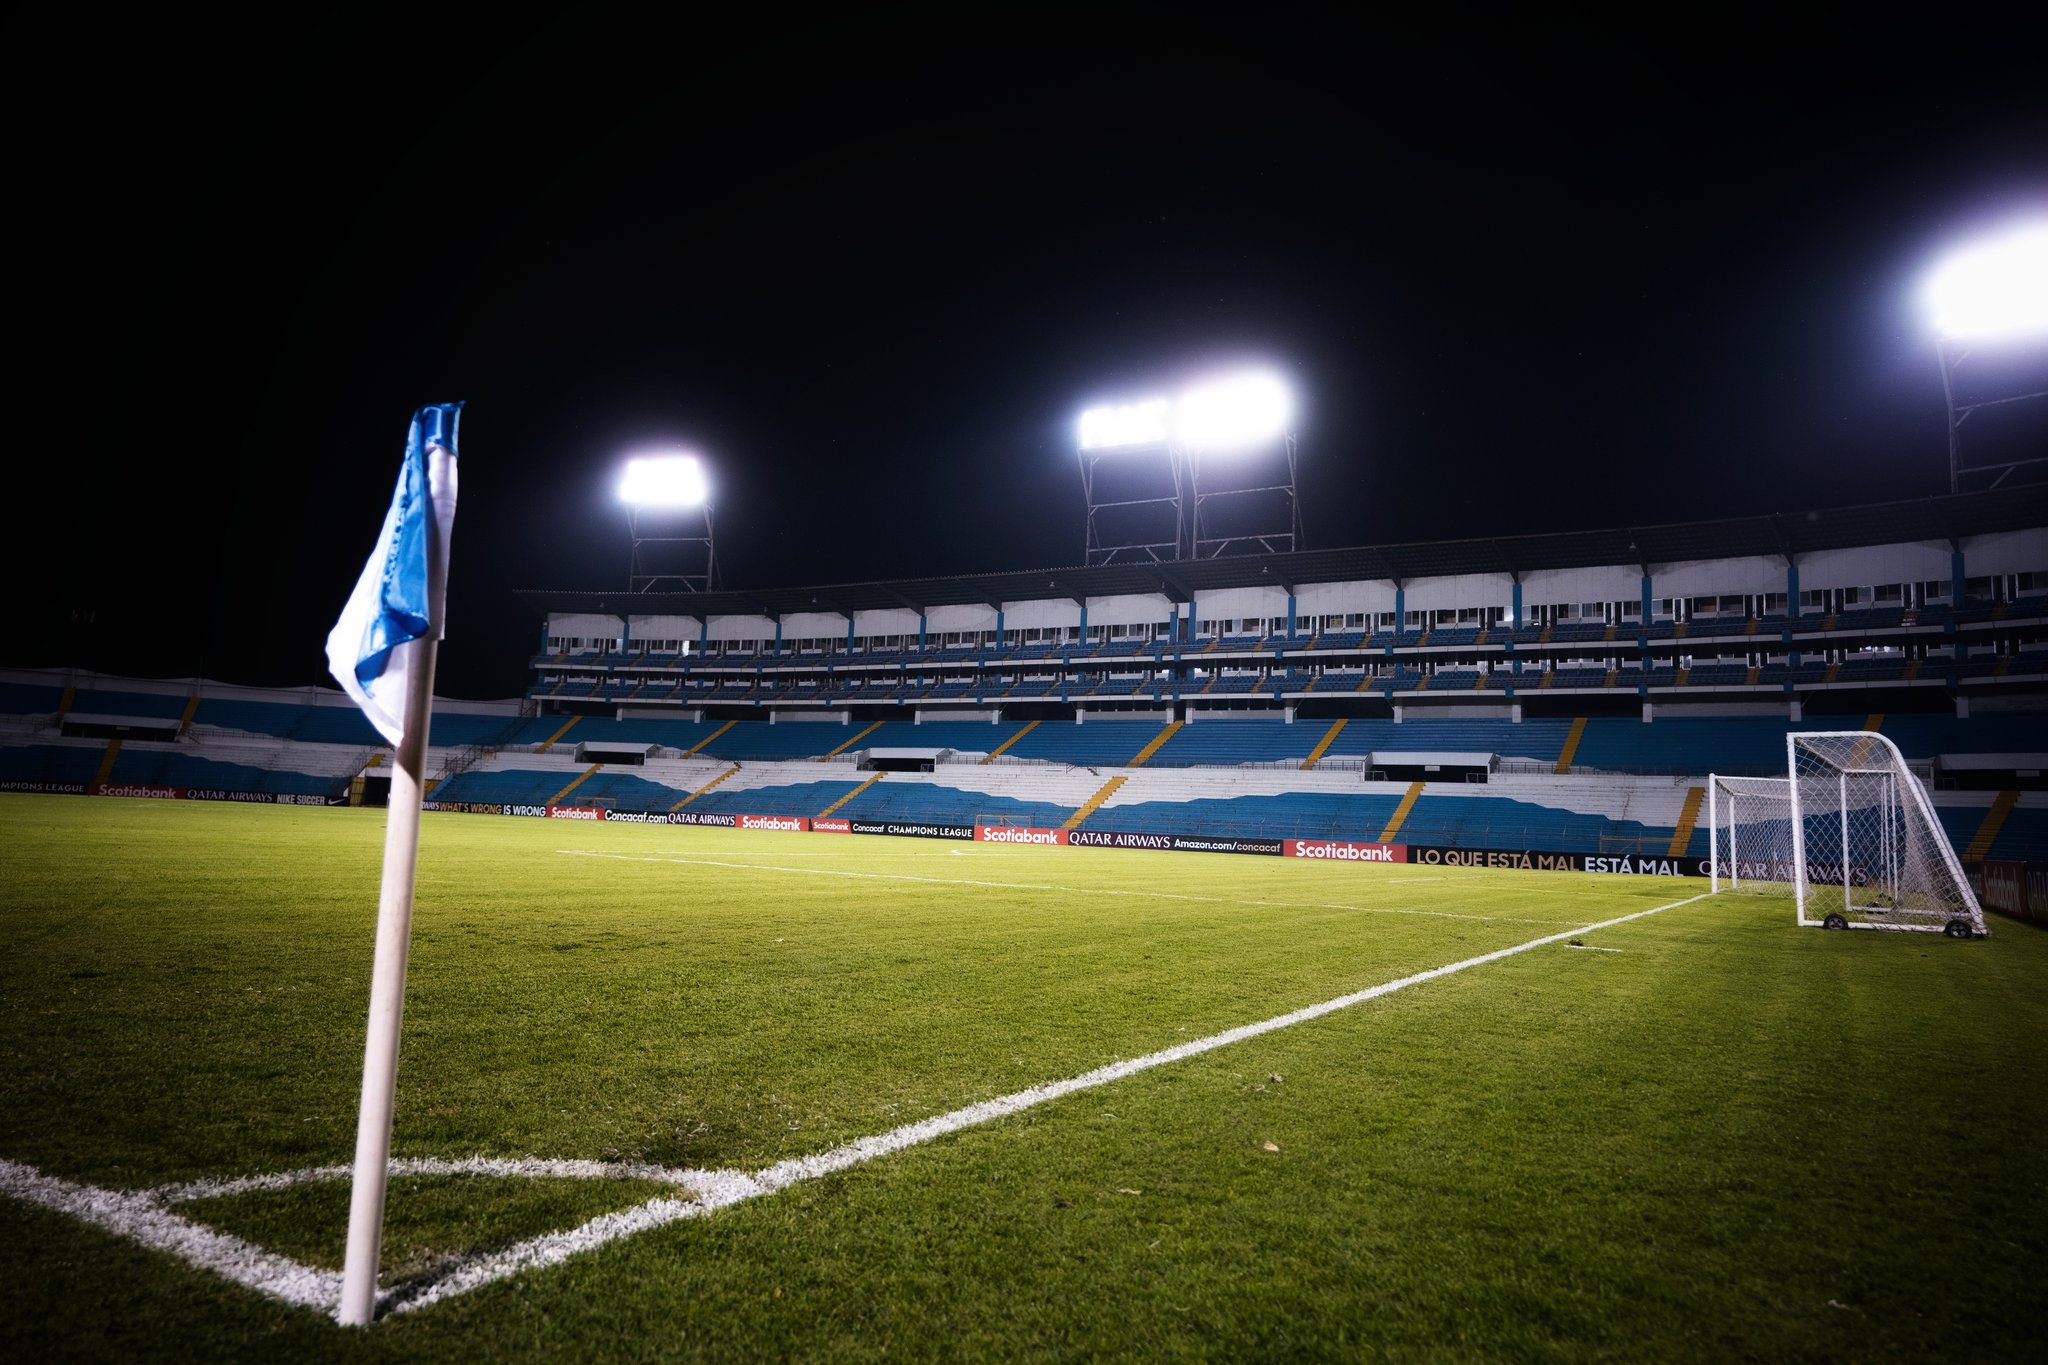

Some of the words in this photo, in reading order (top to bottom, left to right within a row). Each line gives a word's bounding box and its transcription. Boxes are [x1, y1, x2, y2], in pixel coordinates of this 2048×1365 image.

[45, 783, 85, 792] LEAGUE
[99, 785, 176, 798] Scotiabank
[187, 789, 226, 800] QATAR
[227, 791, 273, 802] AIRWAYS
[276, 793, 296, 804] NIKE
[297, 795, 325, 806] SOCCER
[440, 802, 468, 813] WHAT'S
[470, 803, 502, 814] WRONG
[503, 805, 511, 815] IS
[513, 805, 546, 817] WRONG
[551, 807, 598, 820] Scotiabank
[604, 809, 667, 823] Concacaf.com
[668, 812, 696, 824] QATAR
[698, 814, 735, 826] AIRWAYS
[742, 816, 801, 831] Scotiabank
[813, 821, 849, 831] Scotiabank
[852, 823, 885, 833] Concacaf
[887, 825, 938, 836] CHAMPIONS
[940, 828, 972, 838] LEAGUE
[983, 827, 1058, 845] Scotiabank
[1069, 831, 1112, 846] QATAR
[1115, 834, 1171, 848] AIRWAYS
[1174, 838, 1281, 853] Amazon.com/concacaf
[1295, 841, 1393, 862] Scotiabank
[1416, 849, 1441, 864] LO
[1444, 850, 1483, 867] QUE
[1487, 850, 1533, 870] ESTÁ
[1538, 855, 1579, 871] MAL
[1584, 854, 1633, 874] ESTÁ
[1638, 859, 1684, 876] MAL
